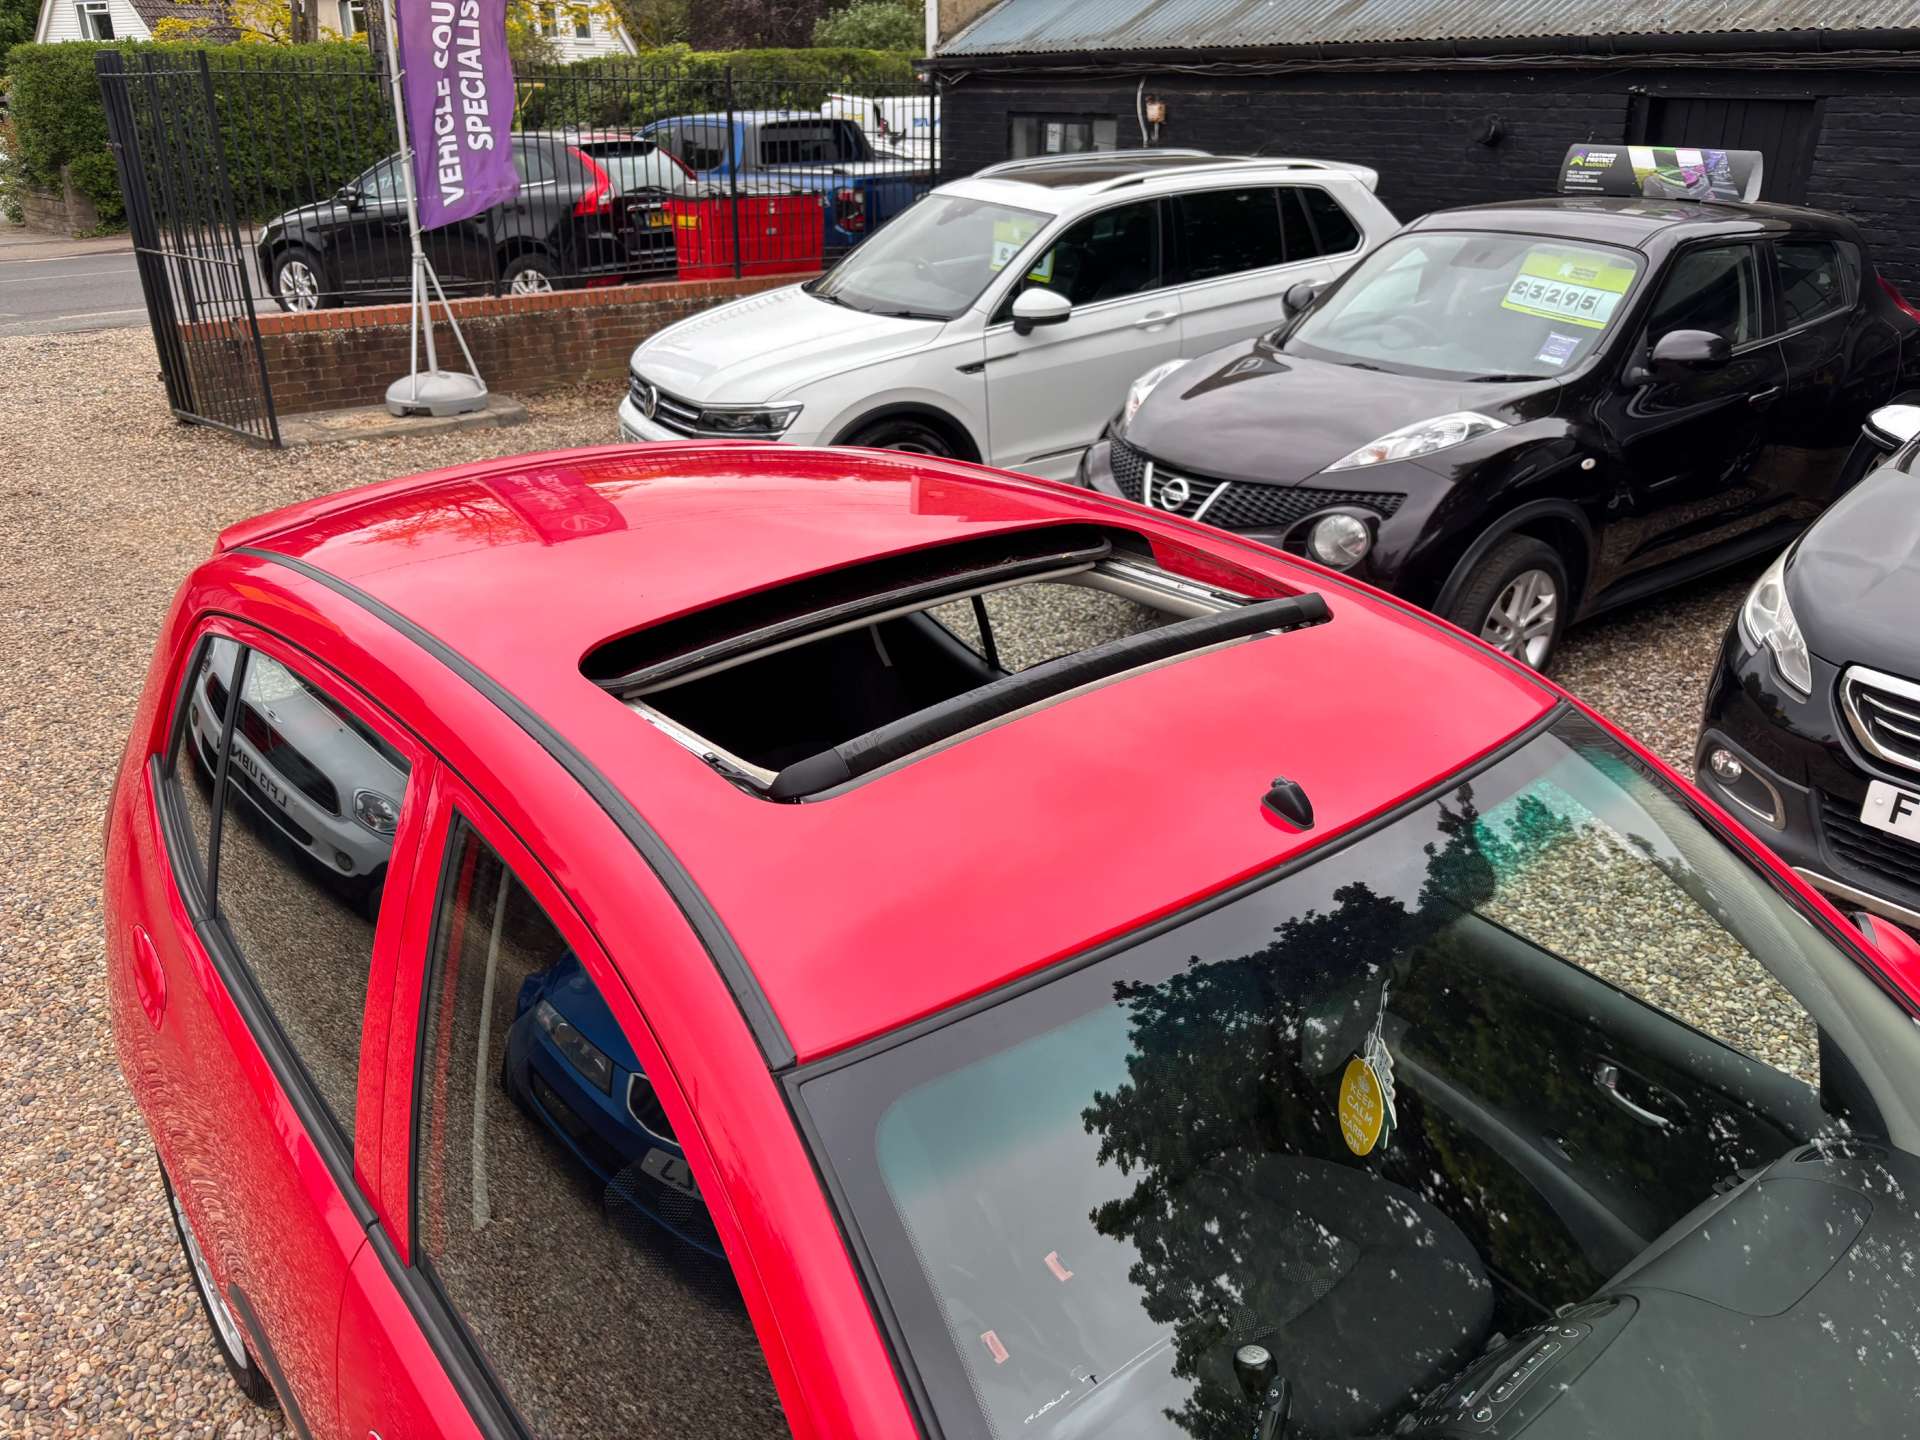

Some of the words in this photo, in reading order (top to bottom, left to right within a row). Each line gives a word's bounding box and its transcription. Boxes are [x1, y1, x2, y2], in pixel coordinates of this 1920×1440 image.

[457, 0, 495, 151] SPECIALIS
[434, 77, 465, 207] VEHICLE
[1511, 281, 1597, 311] £3295
[1347, 1095, 1373, 1127] CALM
[1350, 1082, 1375, 1108] KEEP
[1342, 1111, 1370, 1145] CARRY
[1346, 1133, 1361, 1154] ON
